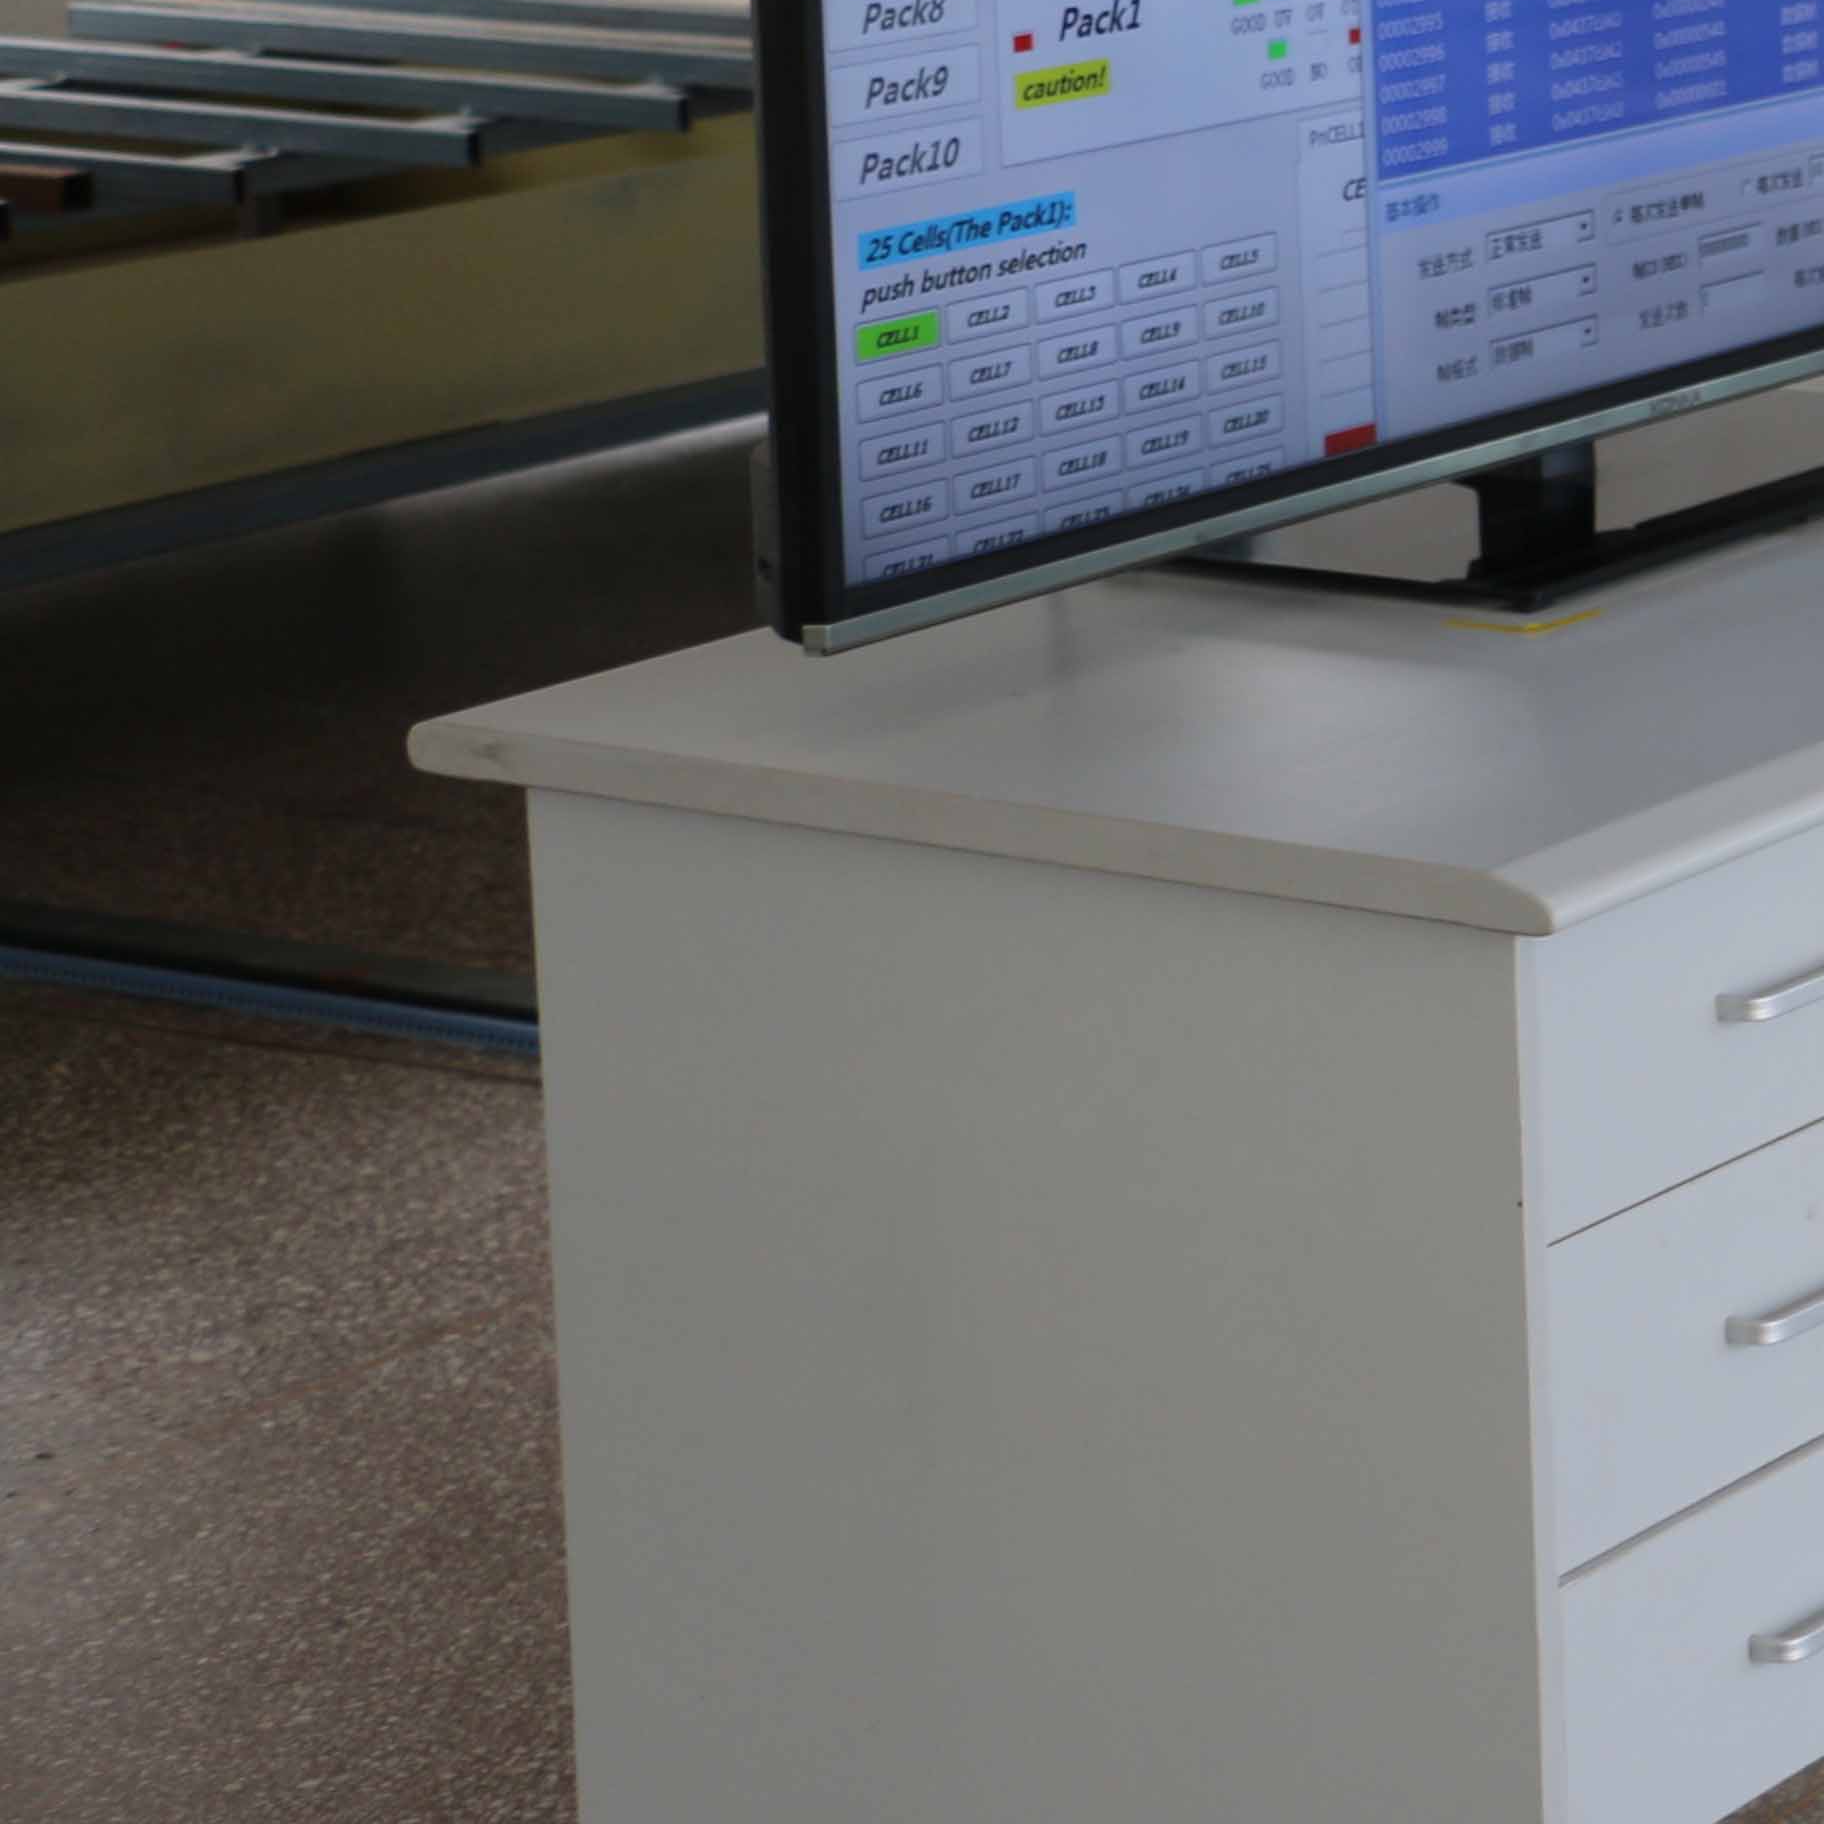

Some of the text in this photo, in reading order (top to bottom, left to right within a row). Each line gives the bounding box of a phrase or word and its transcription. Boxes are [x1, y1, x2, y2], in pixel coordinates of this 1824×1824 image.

[865, 64, 949, 109] Pack9
[1023, 64, 1107, 102] caution!
[859, 136, 961, 185] Pack10
[865, 236, 893, 263] 25
[898, 217, 993, 256] Cells(The
[860, 239, 1087, 315] push button selection
